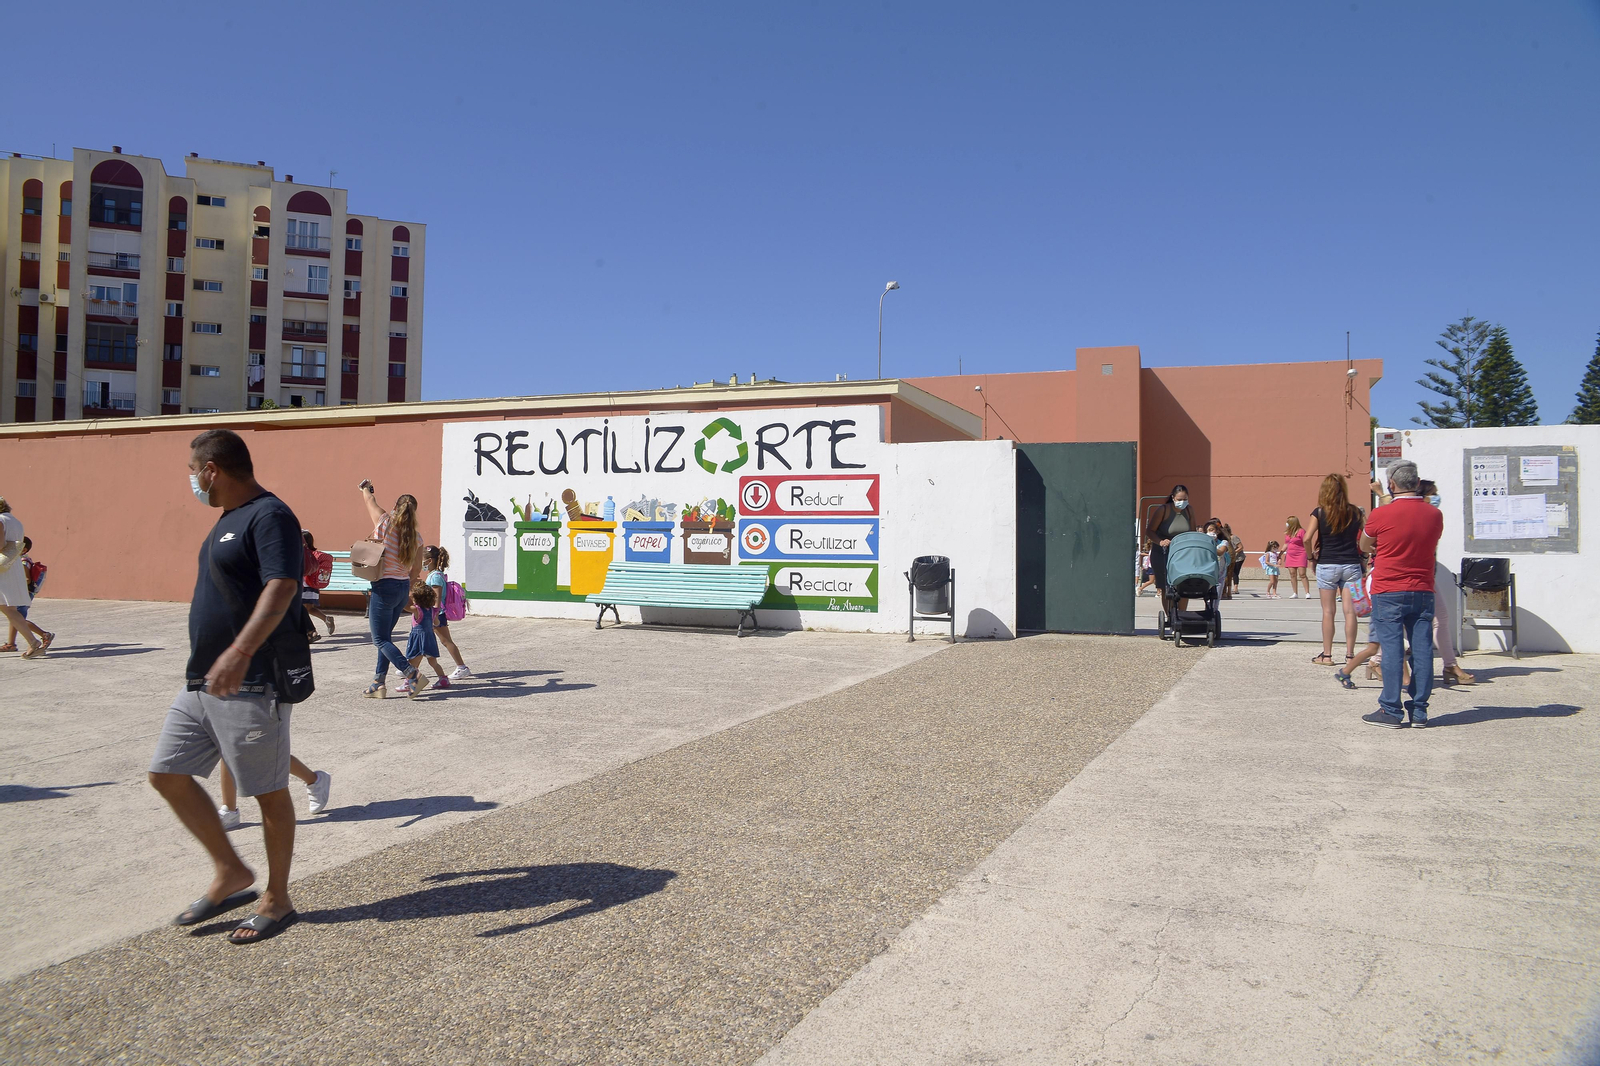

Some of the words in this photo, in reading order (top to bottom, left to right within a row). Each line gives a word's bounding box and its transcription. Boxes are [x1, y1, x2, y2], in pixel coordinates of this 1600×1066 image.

[790, 486, 844, 506] Reducir
[523, 535, 552, 547] vidrios
[789, 529, 858, 549] Reutilizar
[789, 572, 853, 592] Reciclar
[287, 665, 312, 676] Reebok
